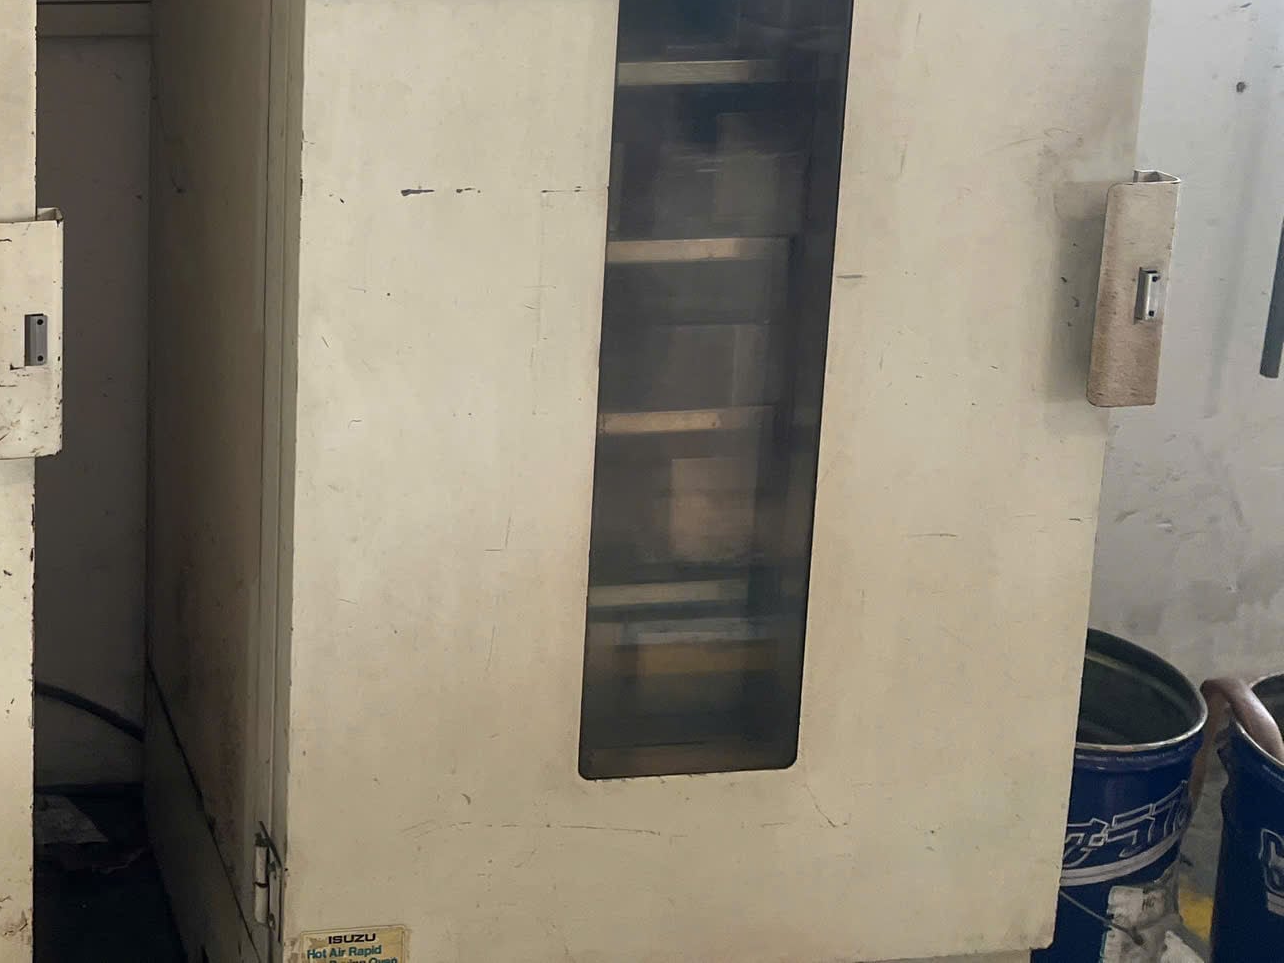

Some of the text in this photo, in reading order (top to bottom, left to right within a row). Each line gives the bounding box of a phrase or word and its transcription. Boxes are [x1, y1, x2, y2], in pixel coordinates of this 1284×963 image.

[328, 933, 376, 944] ISUZU
[307, 945, 382, 959] Hot Air Rapid
